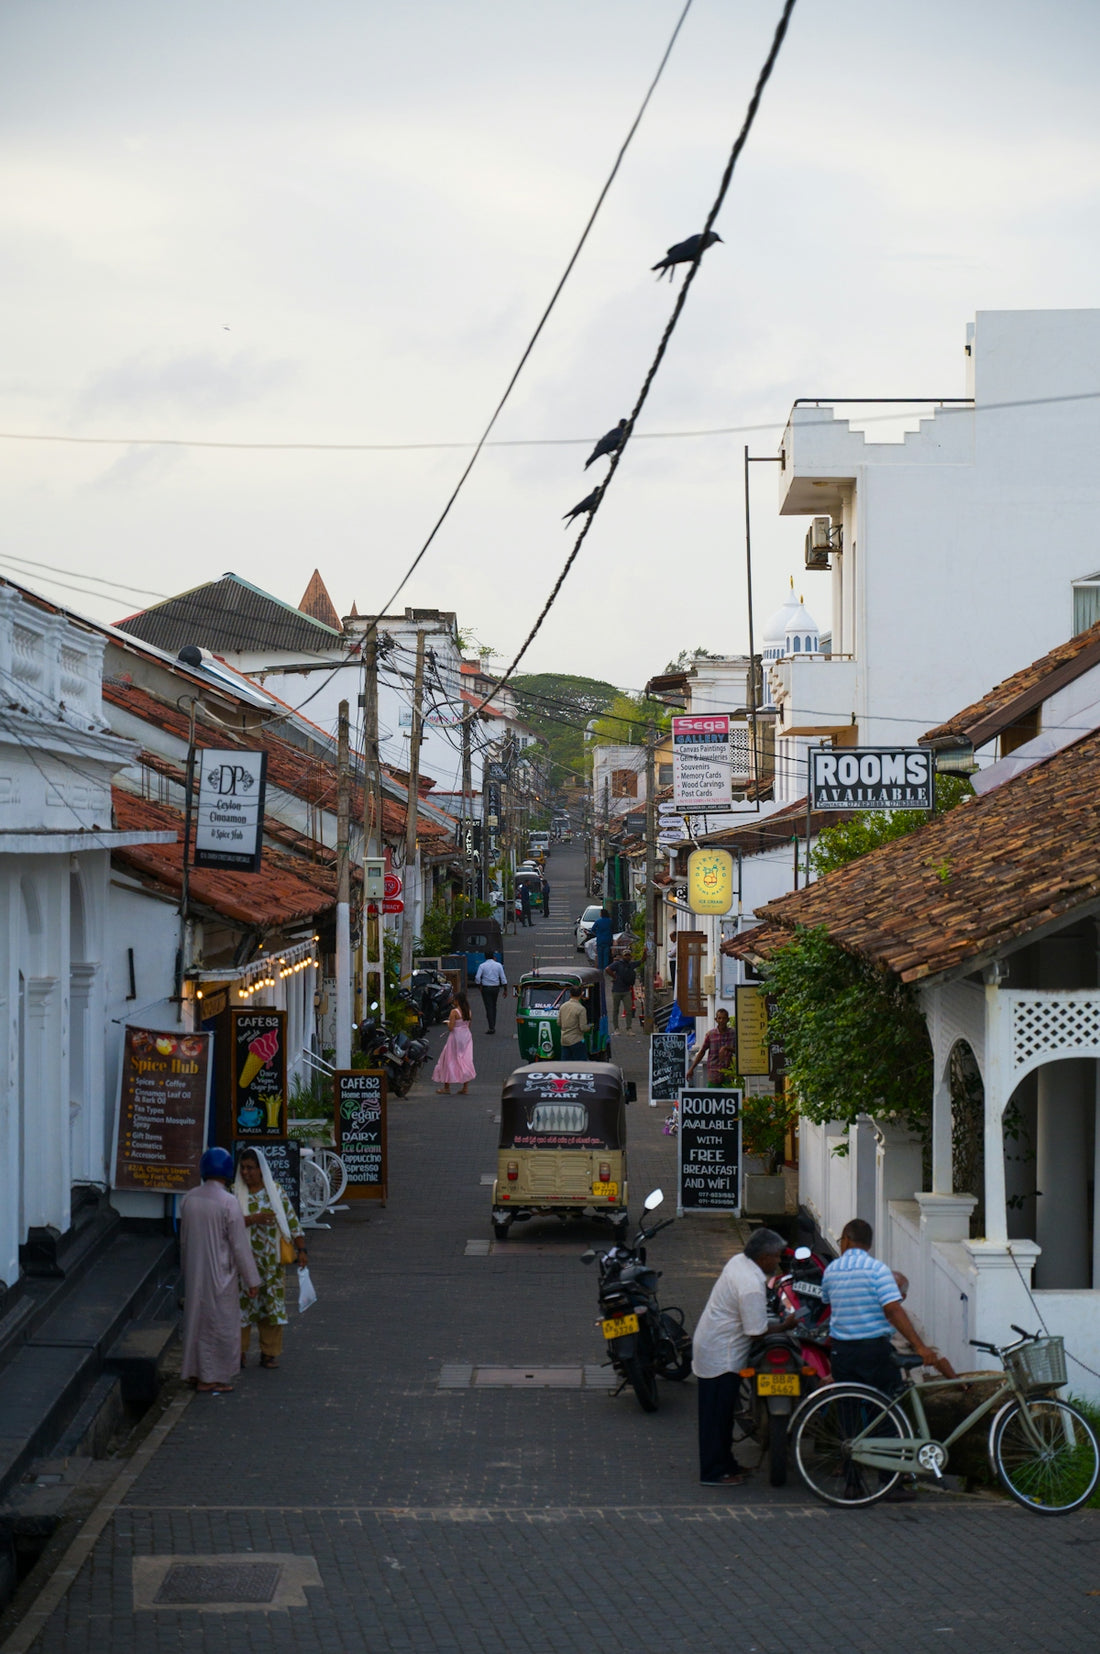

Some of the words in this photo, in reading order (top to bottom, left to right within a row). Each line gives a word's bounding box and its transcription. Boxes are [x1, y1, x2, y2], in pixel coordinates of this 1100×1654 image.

[678, 720, 726, 733] Sega
[676, 734, 725, 743] GALLERY
[680, 745, 699, 753] Canvas
[700, 744, 727, 753] Paintings
[680, 763, 710, 771] Souvenirs
[816, 754, 928, 786] ROOMS
[218, 765, 245, 796] DP
[680, 772, 704, 780] Memory
[705, 771, 722, 779] Cards
[700, 780, 725, 789] Carvings
[682, 789, 694, 797] Post
[696, 788, 713, 797] Cards
[819, 788, 927, 801] AVAILABLE
[216, 799, 242, 812] Ceylon
[209, 811, 247, 824] Cinnamon
[265, 1017, 279, 1027] 82
[130, 1056, 168, 1075] Spice
[171, 1059, 199, 1074] Hub
[527, 1072, 594, 1081] GAME
[165, 1079, 187, 1089] Coffee
[365, 1078, 380, 1089] 82
[341, 1091, 360, 1099] Home
[361, 1090, 381, 1099] made
[682, 1097, 736, 1115] ROOMS
[682, 1119, 735, 1131] AVAILABLE
[342, 1133, 378, 1141] DAIRY
[696, 1135, 723, 1145] WITH
[341, 1143, 355, 1153] Ice
[356, 1143, 382, 1153] Cream
[689, 1148, 726, 1162] FREE
[345, 1164, 379, 1173] spresso
[683, 1163, 738, 1176] BREAKFAST
[347, 1172, 379, 1182] moothie
[684, 1178, 705, 1190] AND
